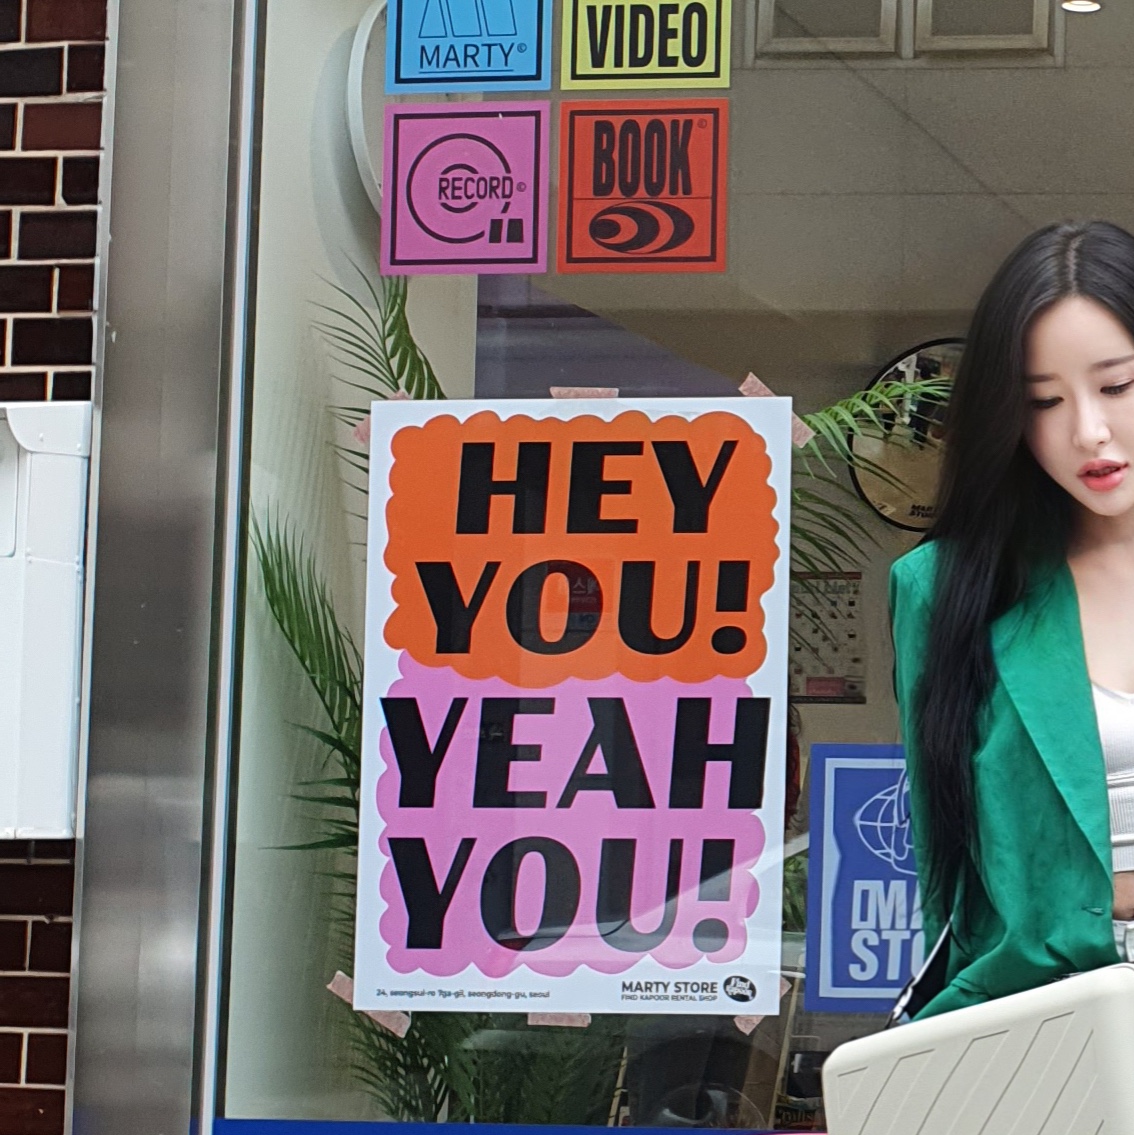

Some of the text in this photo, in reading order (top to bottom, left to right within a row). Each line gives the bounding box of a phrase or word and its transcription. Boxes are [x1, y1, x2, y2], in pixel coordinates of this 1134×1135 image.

[419, 43, 513, 70] MARTY
[587, 2, 708, 69] VIDEO
[438, 176, 513, 201] RECORD
[593, 118, 693, 198] BOOK
[455, 439, 740, 535] HEY
[415, 559, 750, 656] YOU!
[380, 696, 772, 810] YEAH
[388, 836, 735, 954] YOU!
[621, 981, 670, 993] MARTY
[674, 981, 718, 993] STORE
